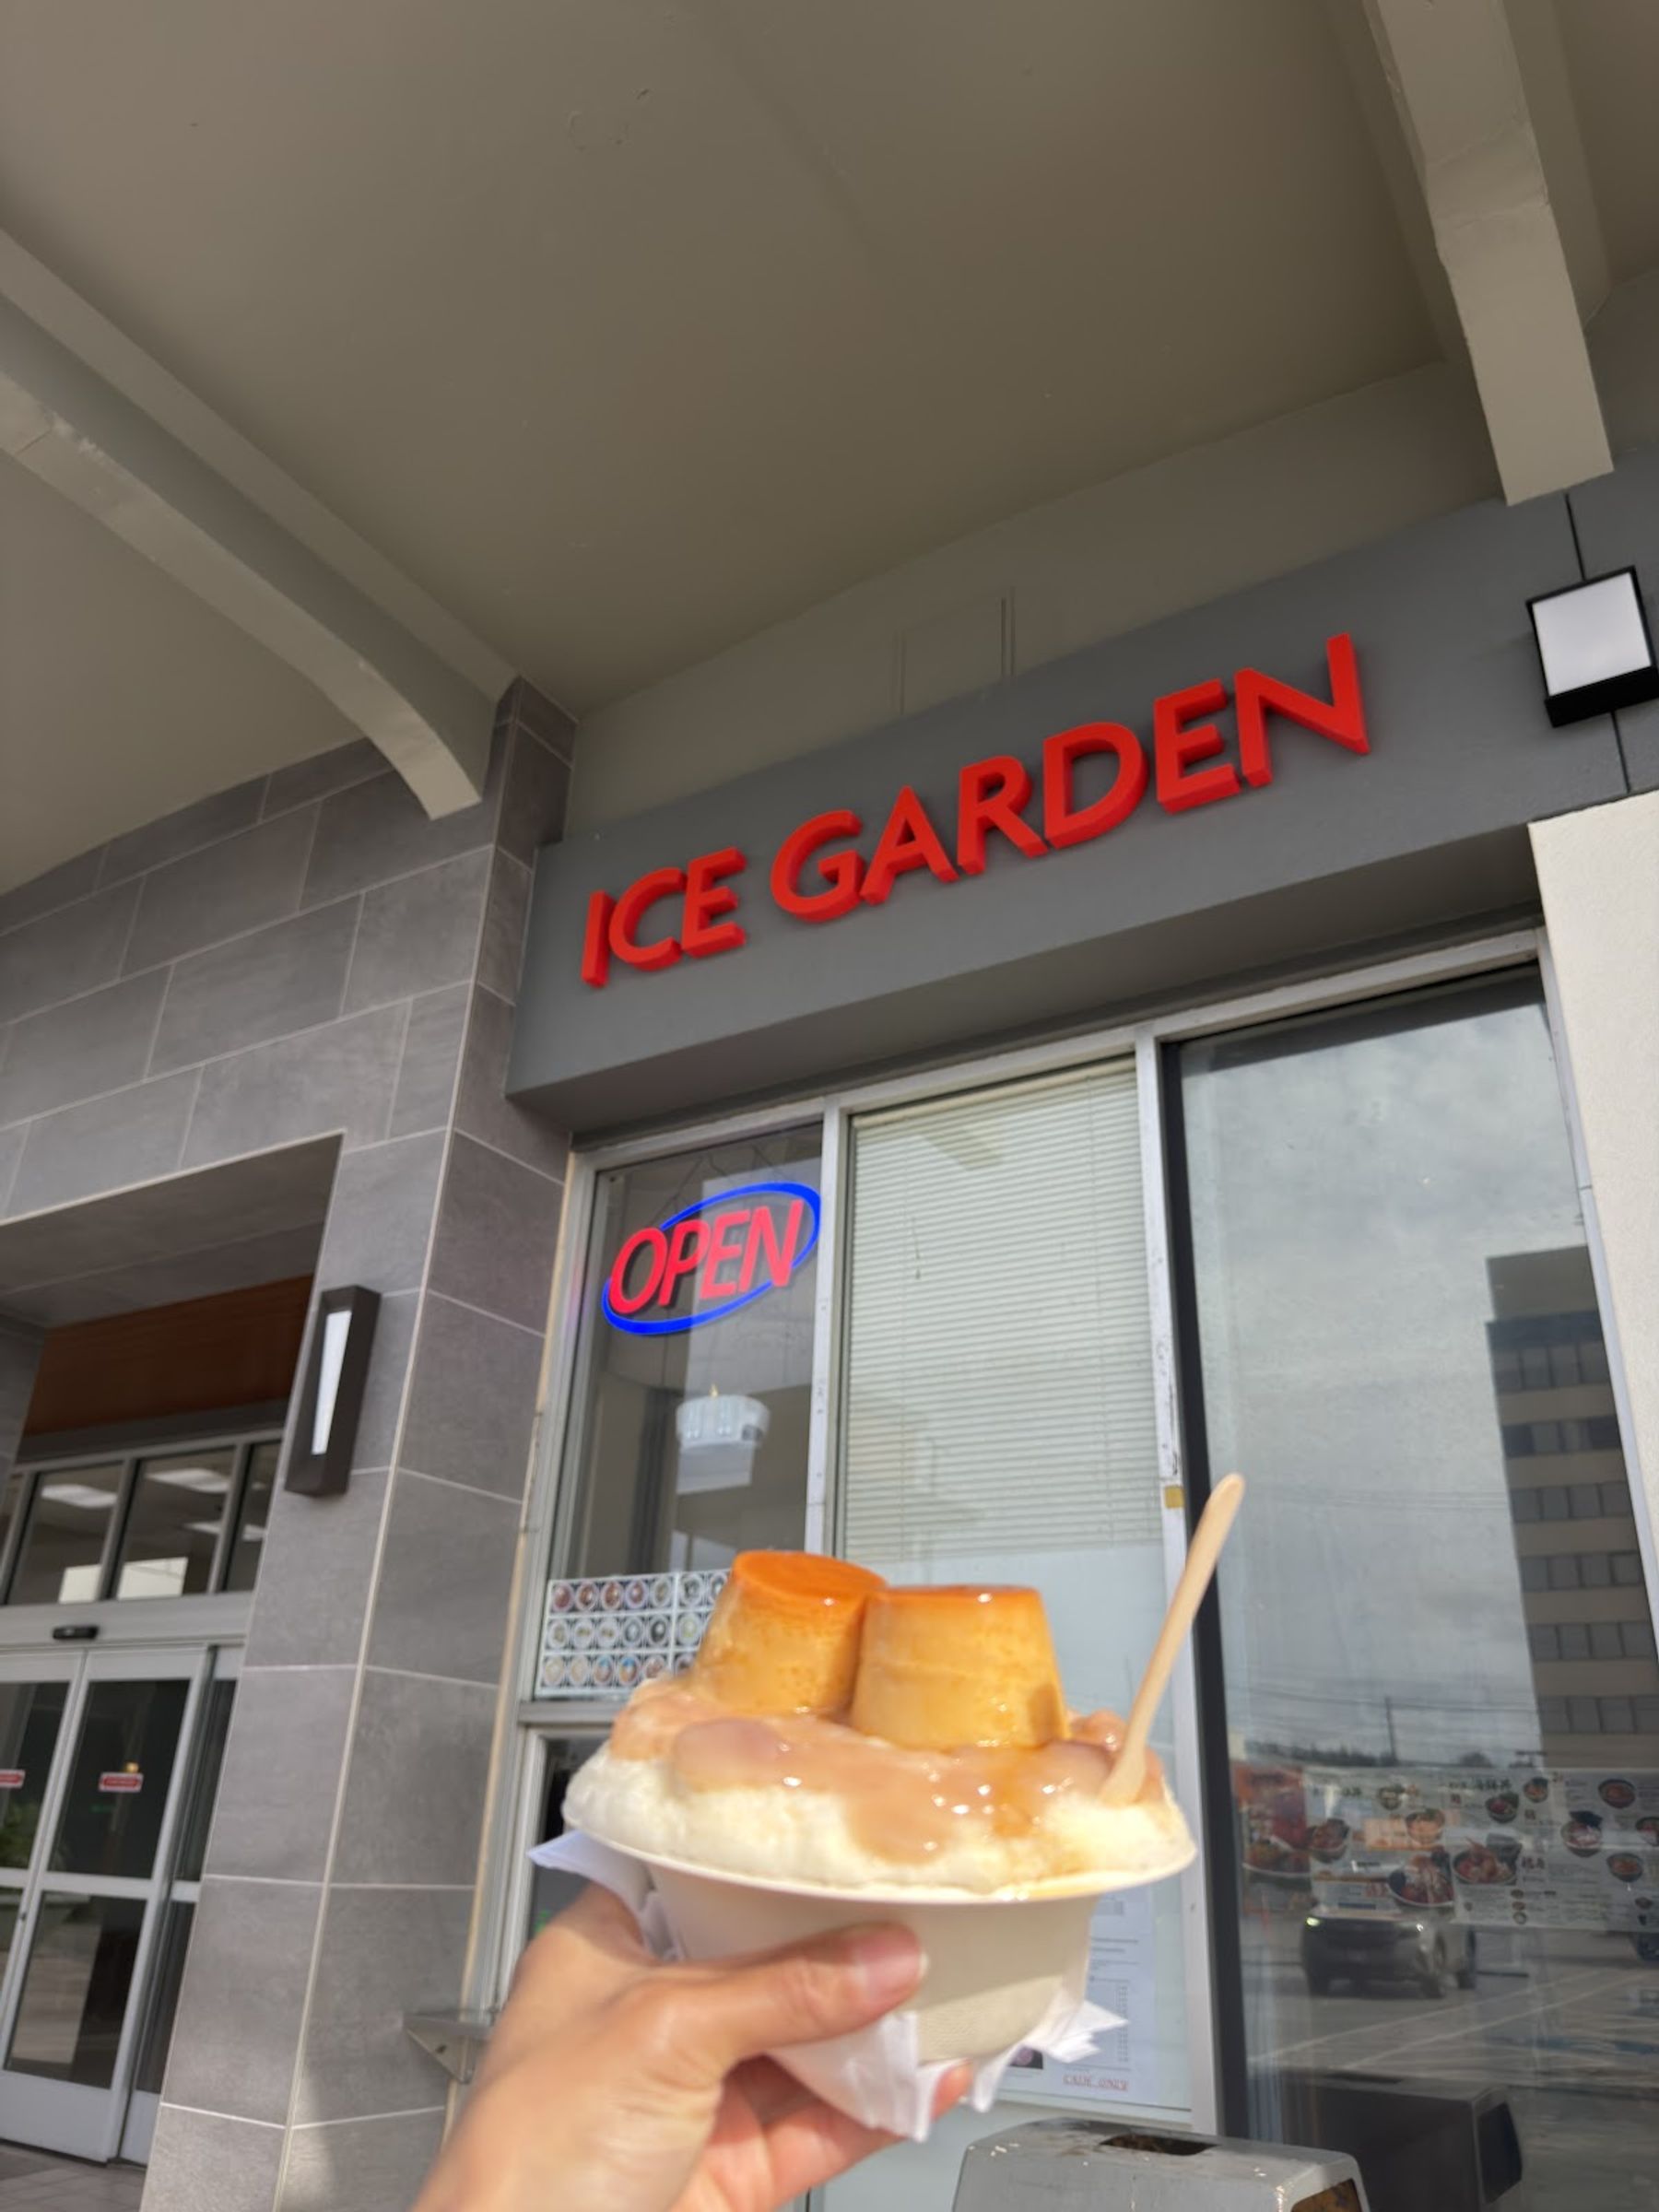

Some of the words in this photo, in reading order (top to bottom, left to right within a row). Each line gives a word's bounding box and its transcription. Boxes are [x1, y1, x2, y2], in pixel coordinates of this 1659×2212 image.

[581, 848, 747, 988] ICE
[771, 633, 1370, 923] GARDEN
[608, 1199, 804, 1314] OPEN
